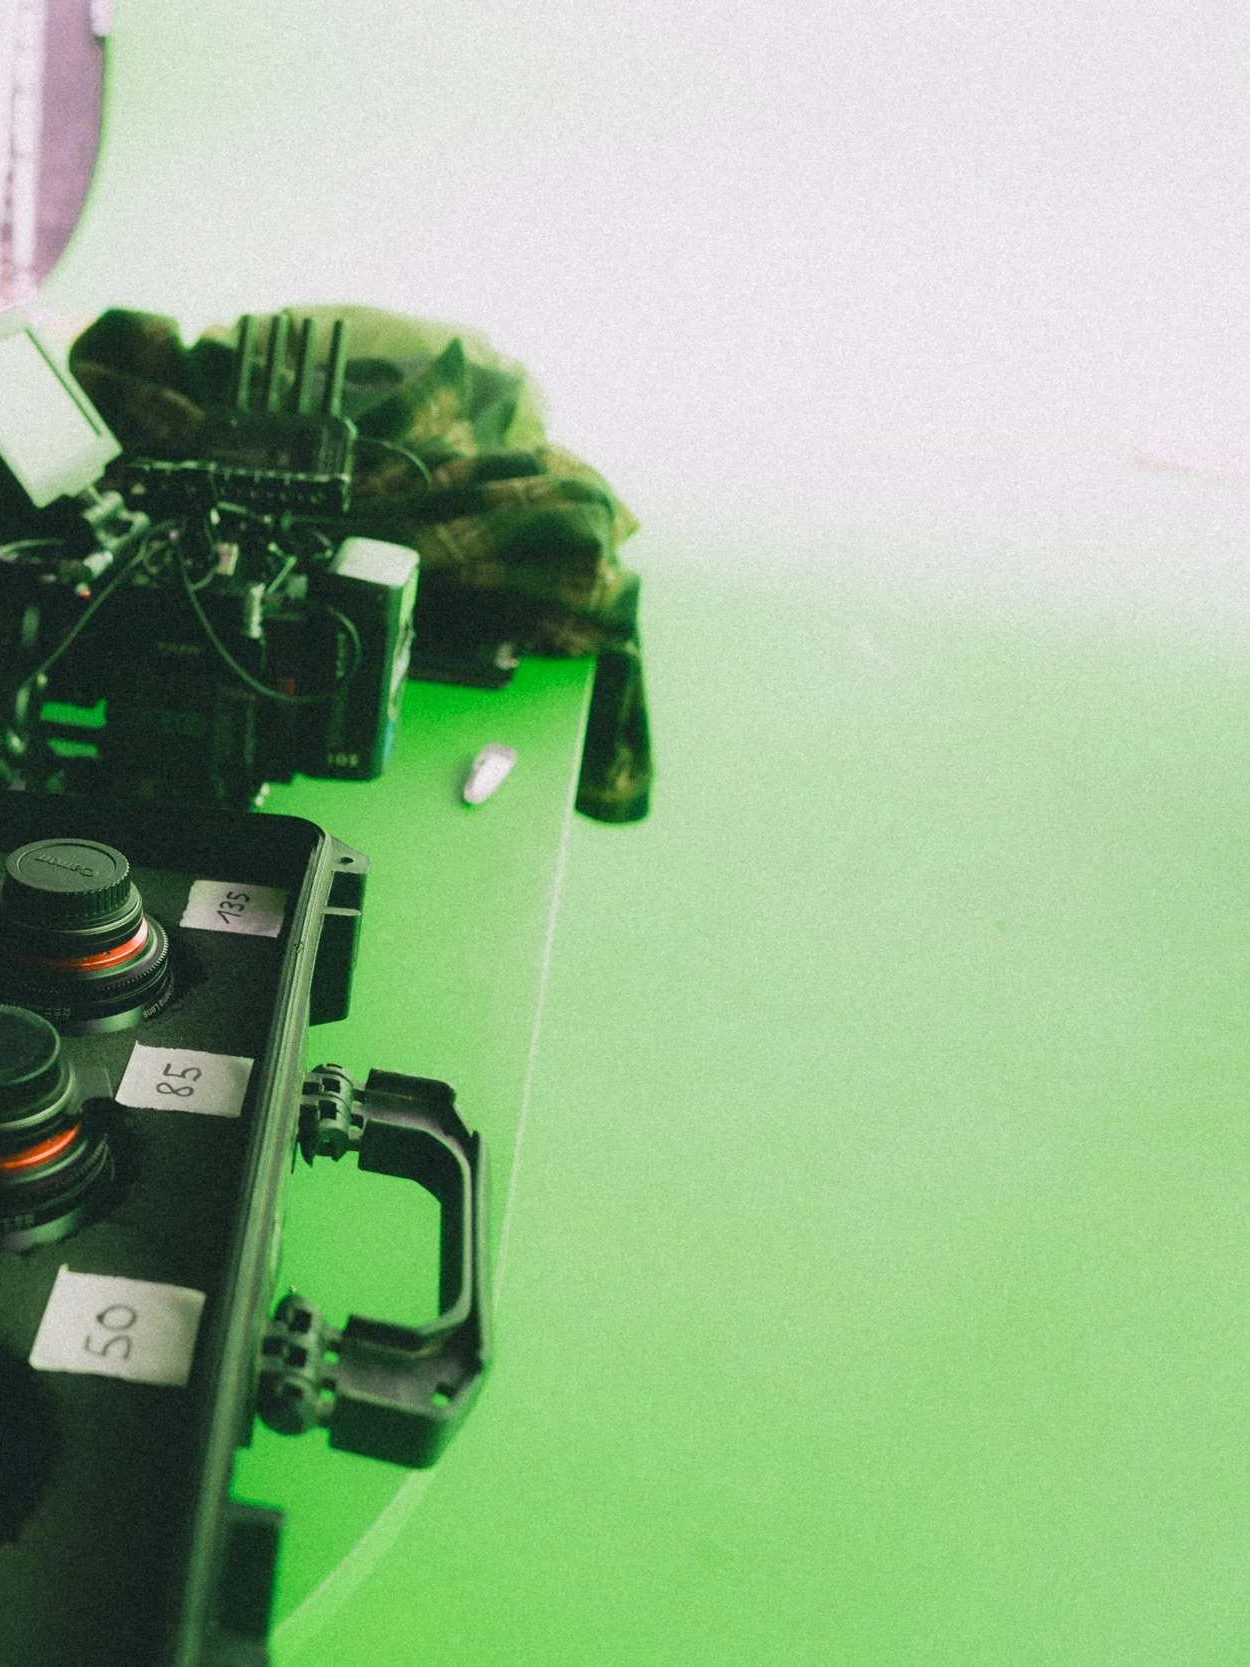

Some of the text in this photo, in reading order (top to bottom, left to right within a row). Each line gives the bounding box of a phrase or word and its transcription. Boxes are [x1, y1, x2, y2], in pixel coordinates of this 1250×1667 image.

[216, 891, 250, 925] 135
[142, 1003, 161, 1018] Lens
[155, 1062, 203, 1098] 85
[83, 1303, 139, 1361] 50
